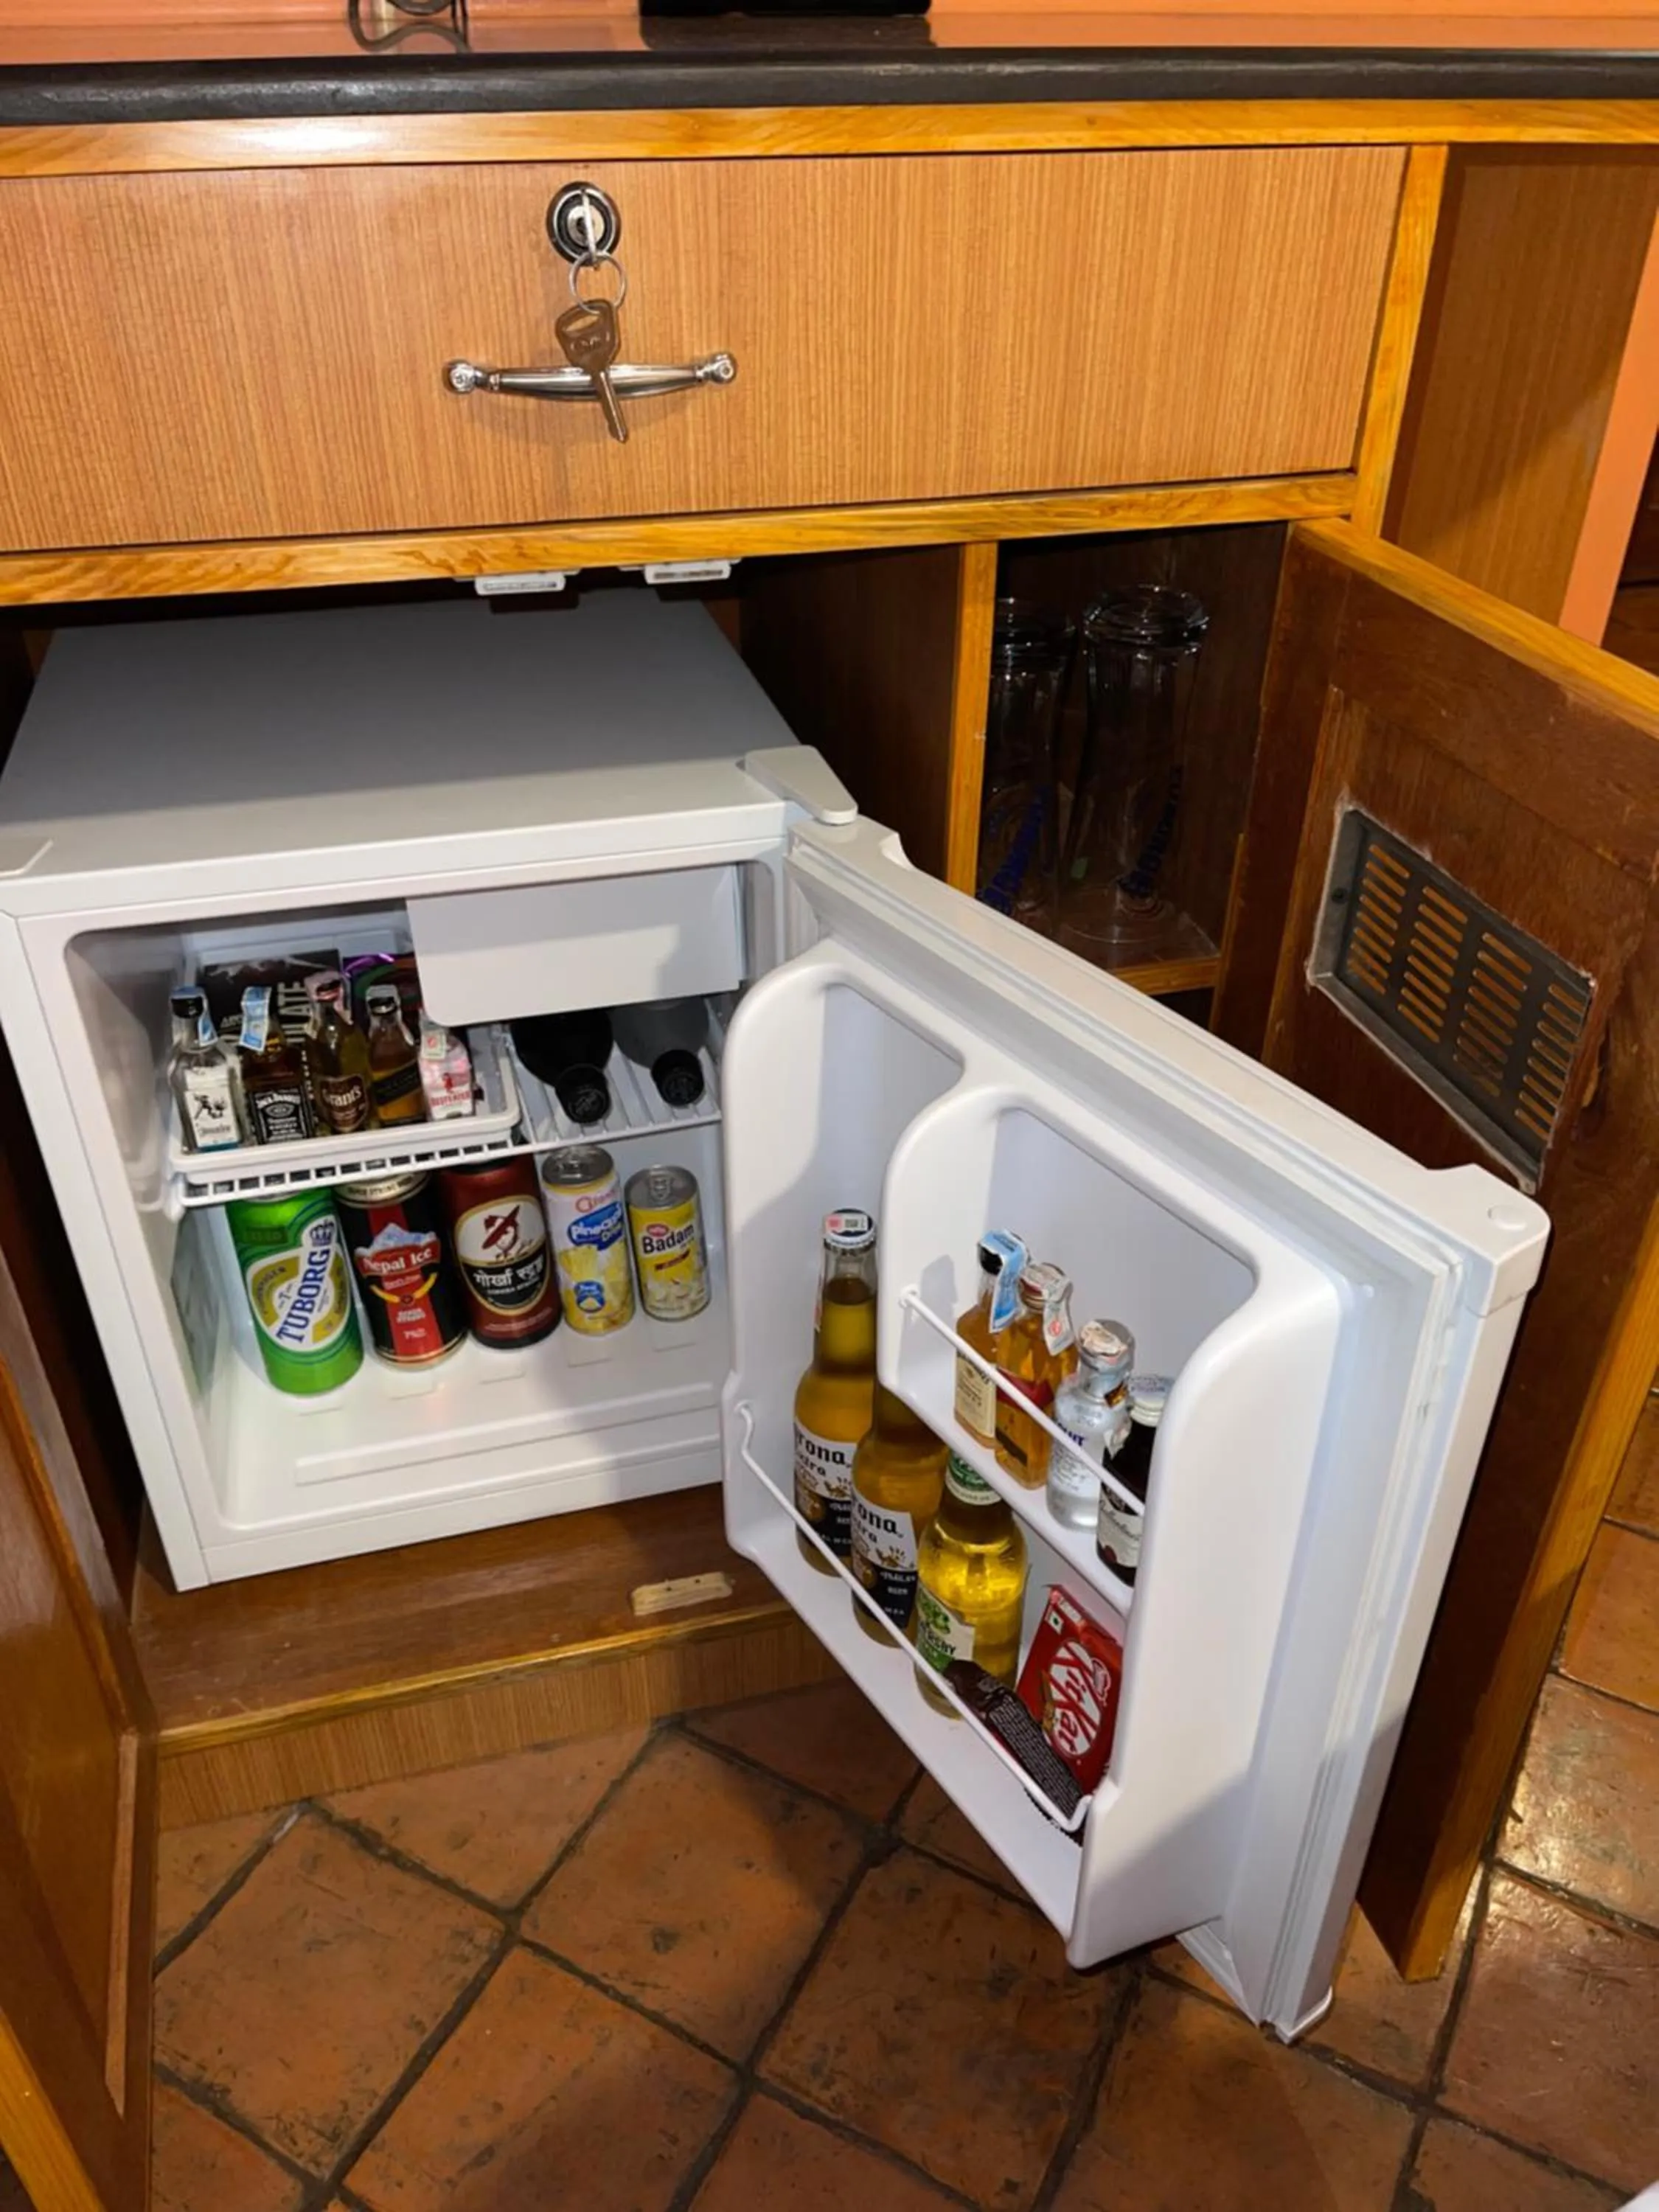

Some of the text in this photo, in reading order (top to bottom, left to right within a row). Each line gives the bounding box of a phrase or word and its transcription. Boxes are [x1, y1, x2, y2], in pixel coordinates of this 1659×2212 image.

[642, 1224, 695, 1254] Badam
[363, 1247, 434, 1275] Nepal Ice
[275, 1248, 331, 1343] TUBORG
[796, 1432, 847, 1465] rona
[1049, 1641, 1102, 1754] KitKat
